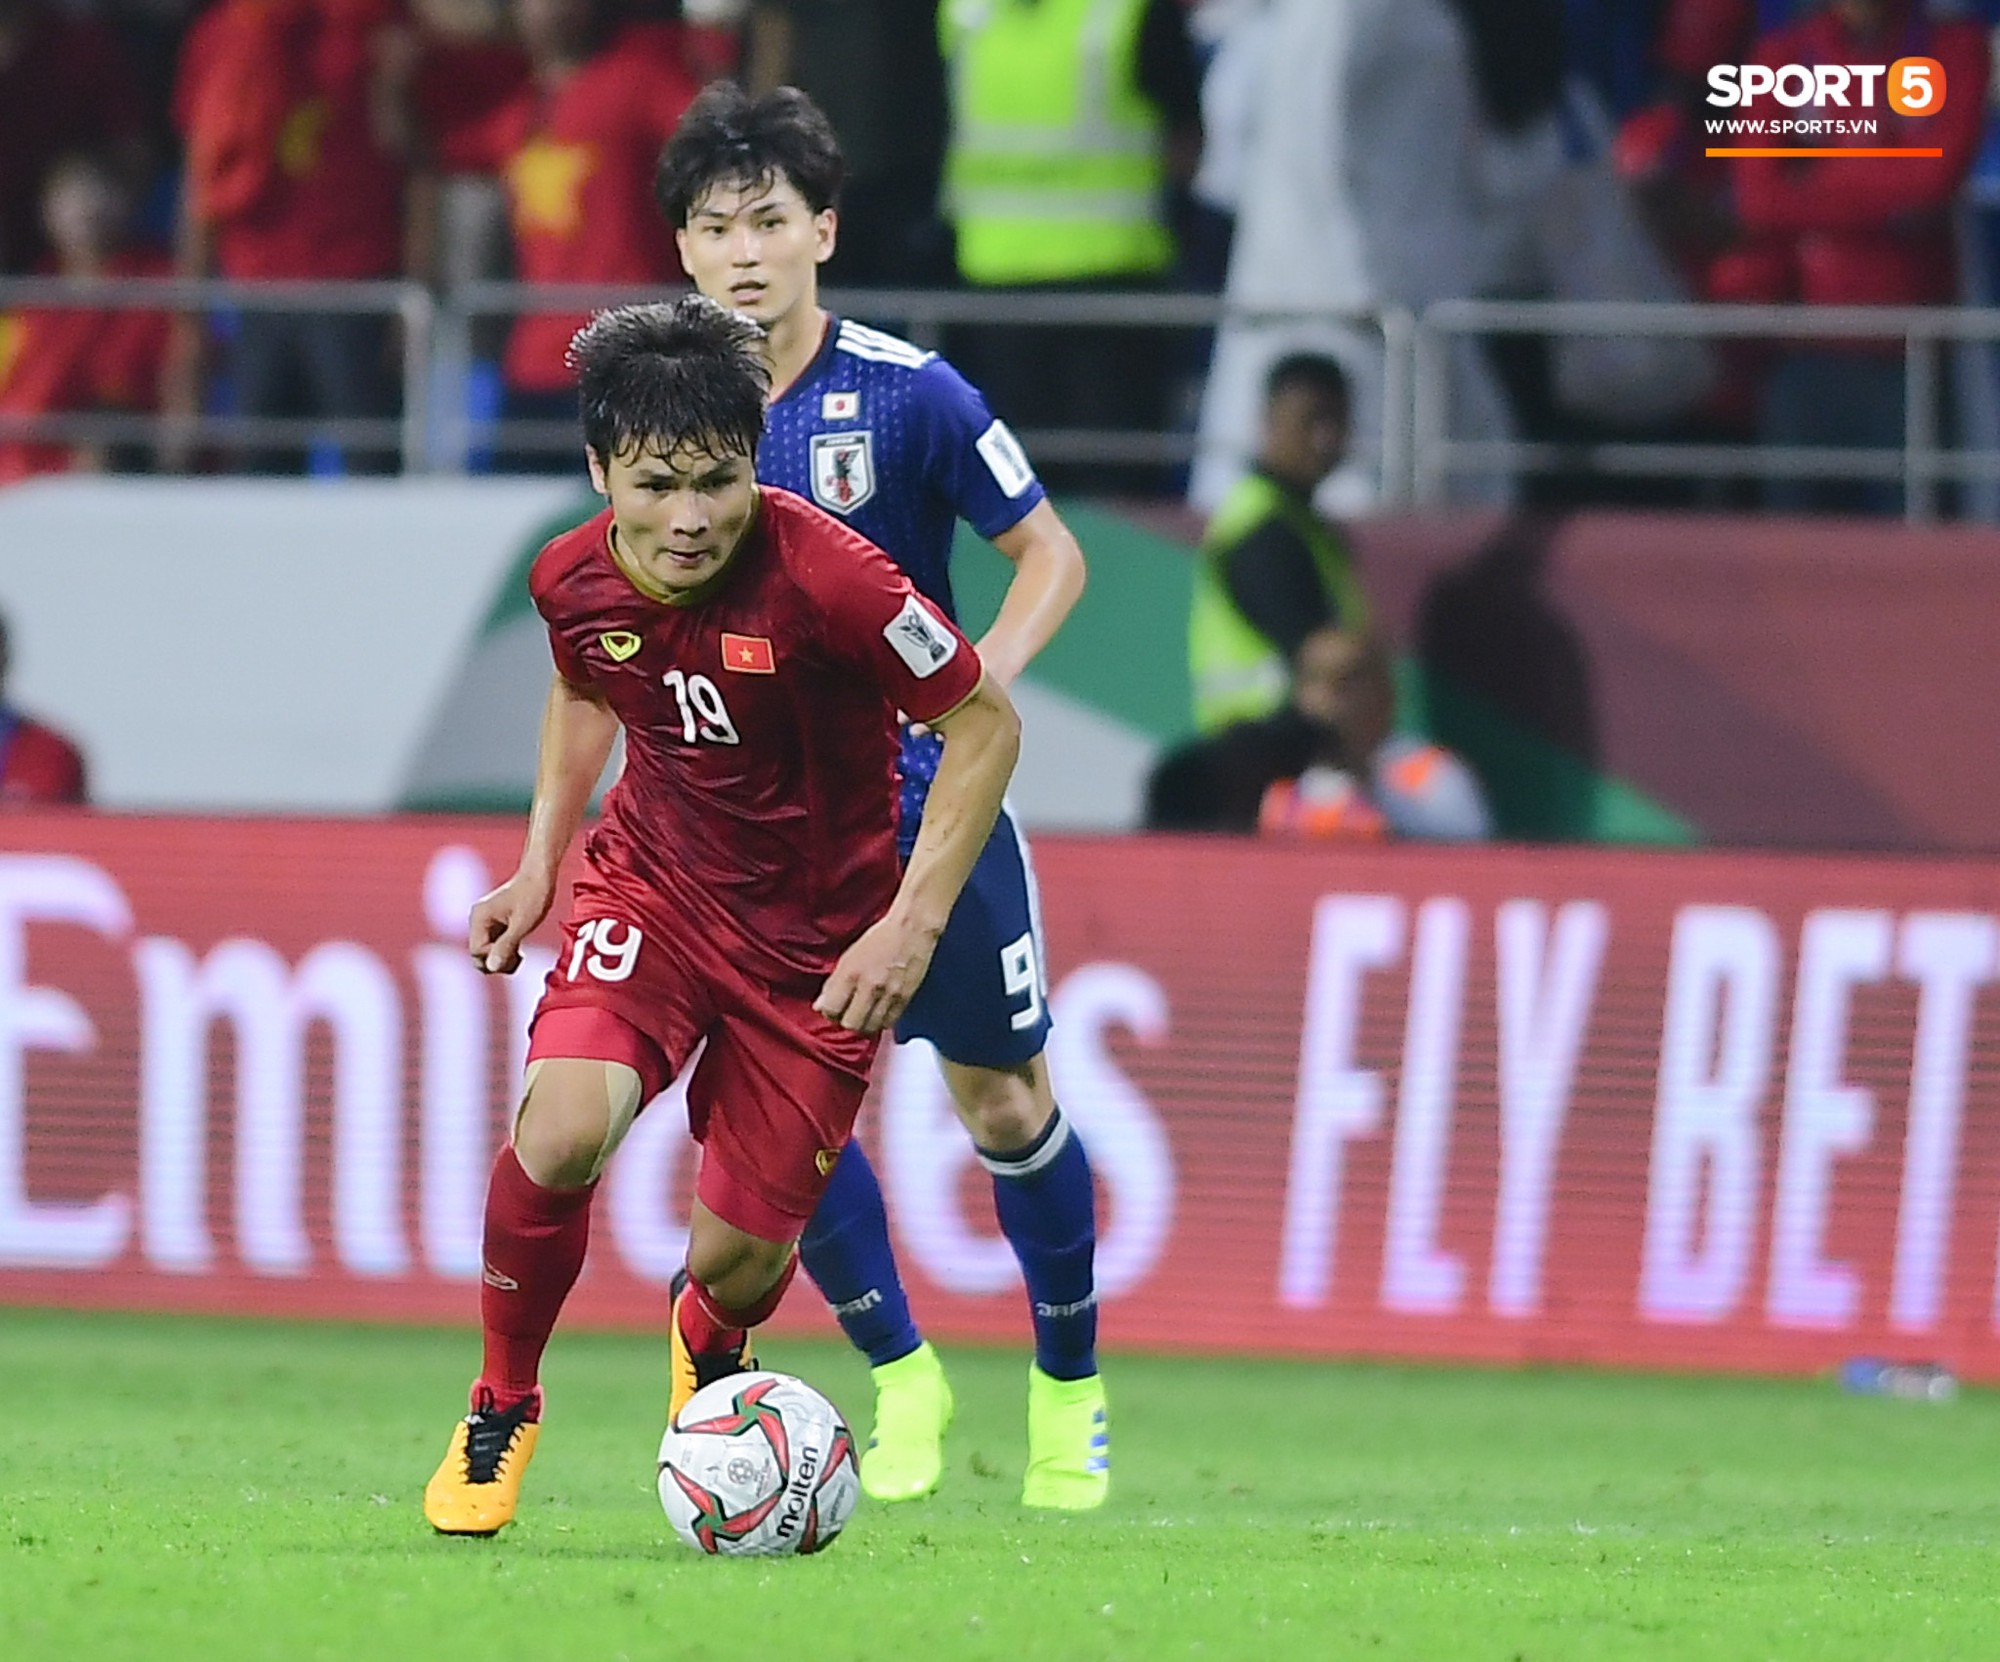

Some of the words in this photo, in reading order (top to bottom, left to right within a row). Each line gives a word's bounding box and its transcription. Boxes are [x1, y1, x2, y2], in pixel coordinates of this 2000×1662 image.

[662, 669, 740, 745] 19
[566, 918, 642, 982] 19
[1000, 930, 1040, 1031] 9
[1277, 893, 1610, 1319] FLY
[776, 1446, 819, 1538] molten
